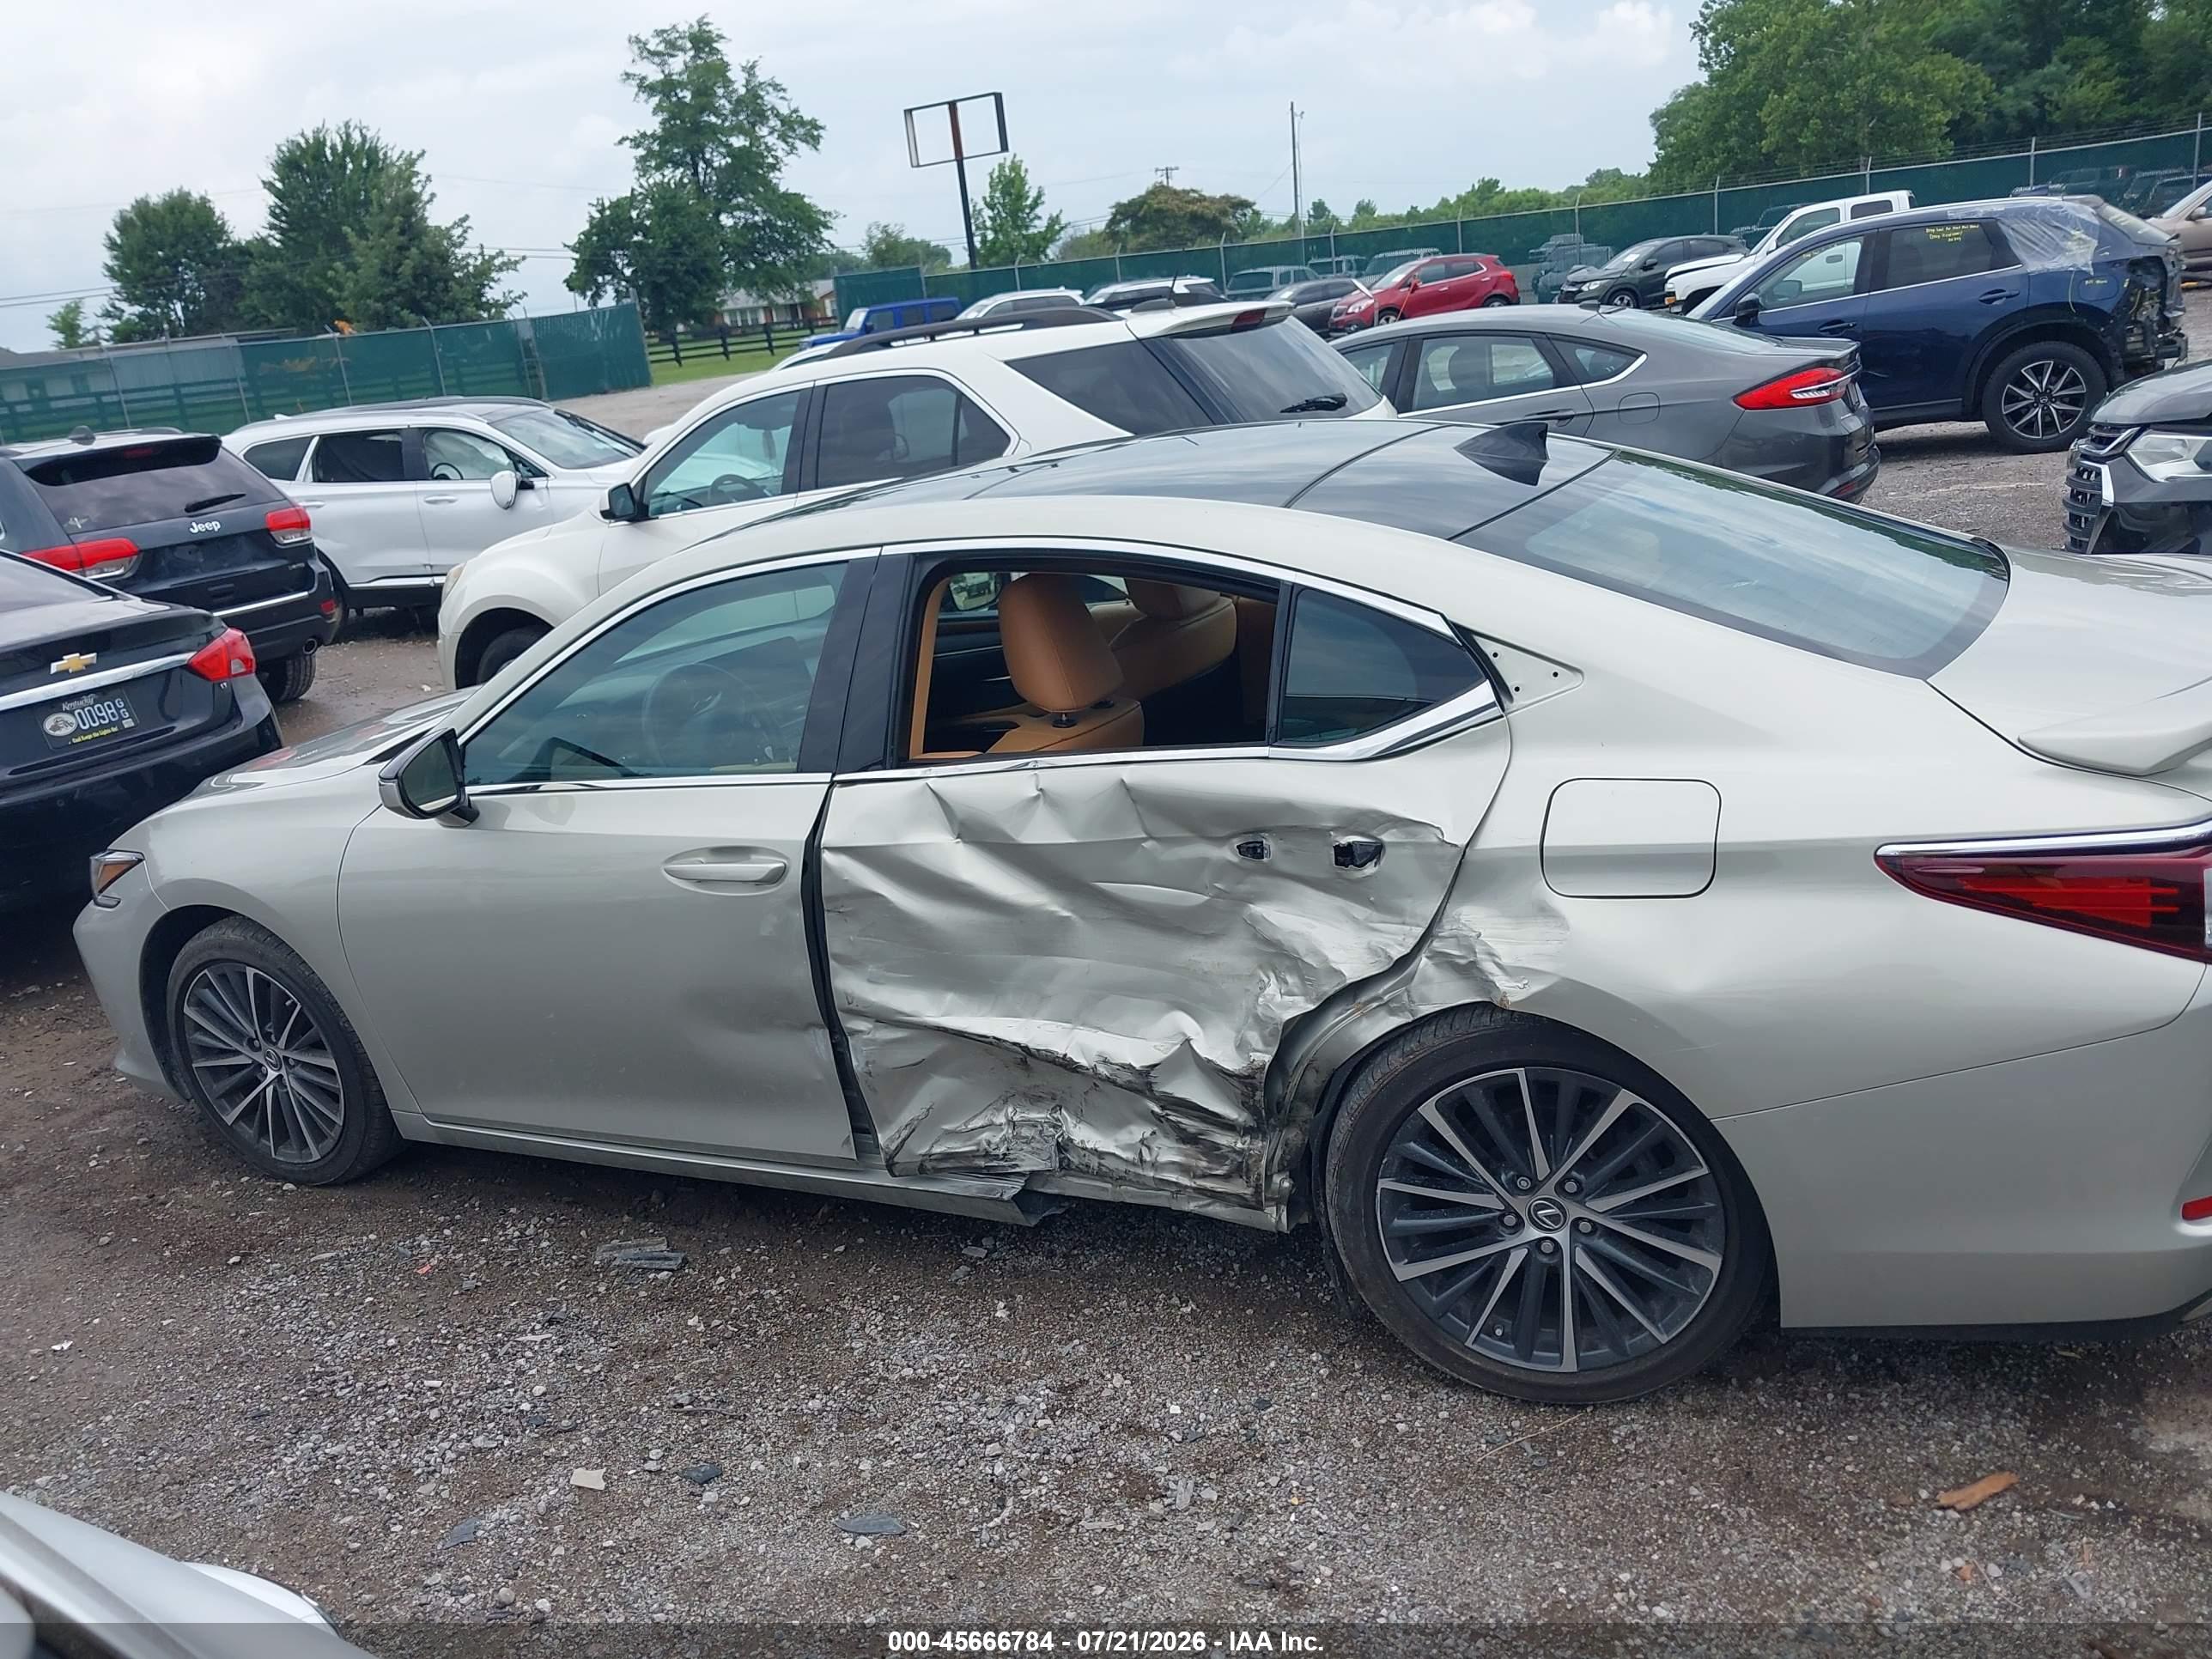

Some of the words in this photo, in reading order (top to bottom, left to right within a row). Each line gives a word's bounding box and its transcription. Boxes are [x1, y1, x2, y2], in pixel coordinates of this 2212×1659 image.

[190, 520, 221, 533] Jeep
[62, 696, 94, 711] Kentucky
[115, 698, 125, 708] G
[74, 701, 119, 730] 0098
[120, 708, 130, 718] G
